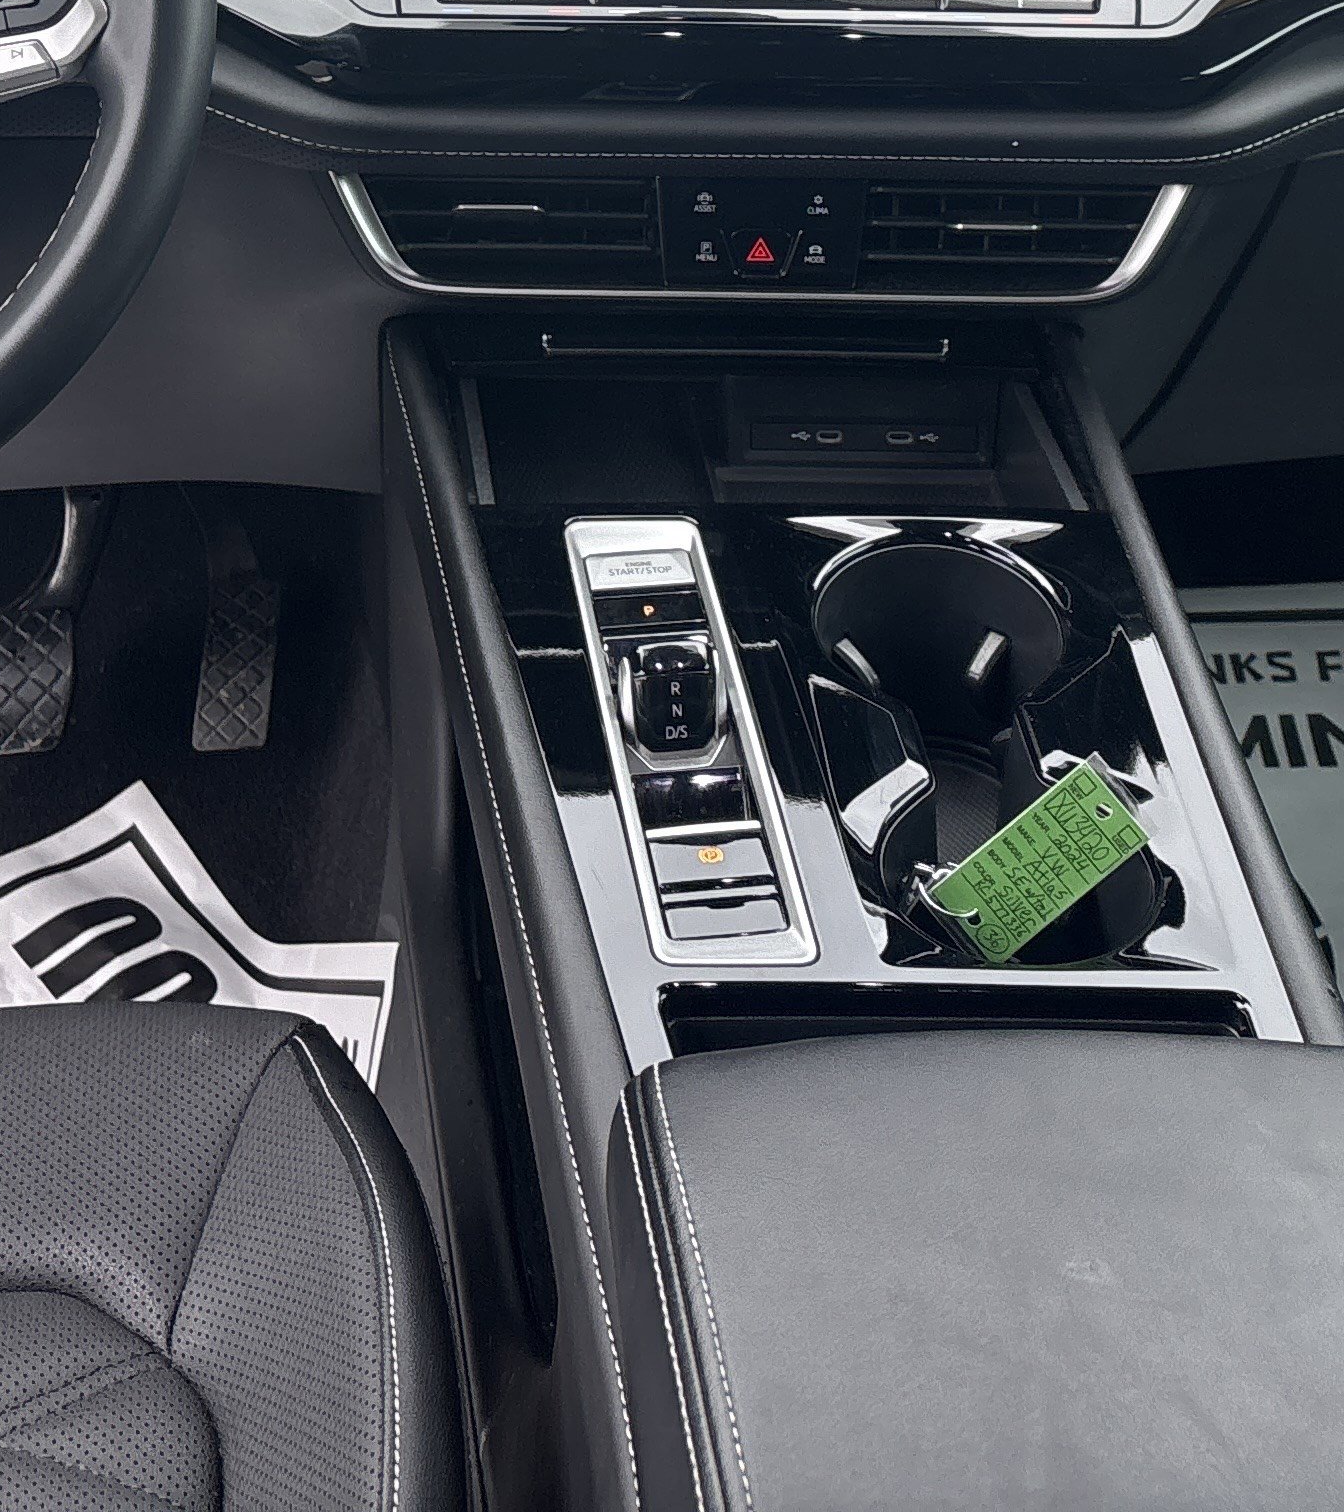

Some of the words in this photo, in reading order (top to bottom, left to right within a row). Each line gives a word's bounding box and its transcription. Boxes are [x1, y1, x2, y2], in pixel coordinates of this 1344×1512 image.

[694, 204, 717, 213] ASSIST
[806, 206, 830, 215] CLIMA
[695, 253, 718, 262] MENU
[804, 255, 826, 264] MODE
[608, 565, 673, 577] START/STOP
[625, 560, 652, 568] ENGINE
[643, 605, 655, 617] P
[670, 681, 681, 696] R
[671, 703, 683, 718] N
[665, 724, 689, 740] D/S
[1067, 782, 1085, 801] NEW
[1031, 811, 1051, 834] YEAR
[1016, 824, 1037, 846] MAKE
[1052, 833, 1091, 871] 2024
[1111, 834, 1130, 855] USED
[986, 848, 1007, 869] BODY
[1043, 845, 1071, 877] VW
[972, 860, 996, 886] COLOR
[1022, 859, 1069, 901] Atlas
[982, 928, 1006, 949] 36
